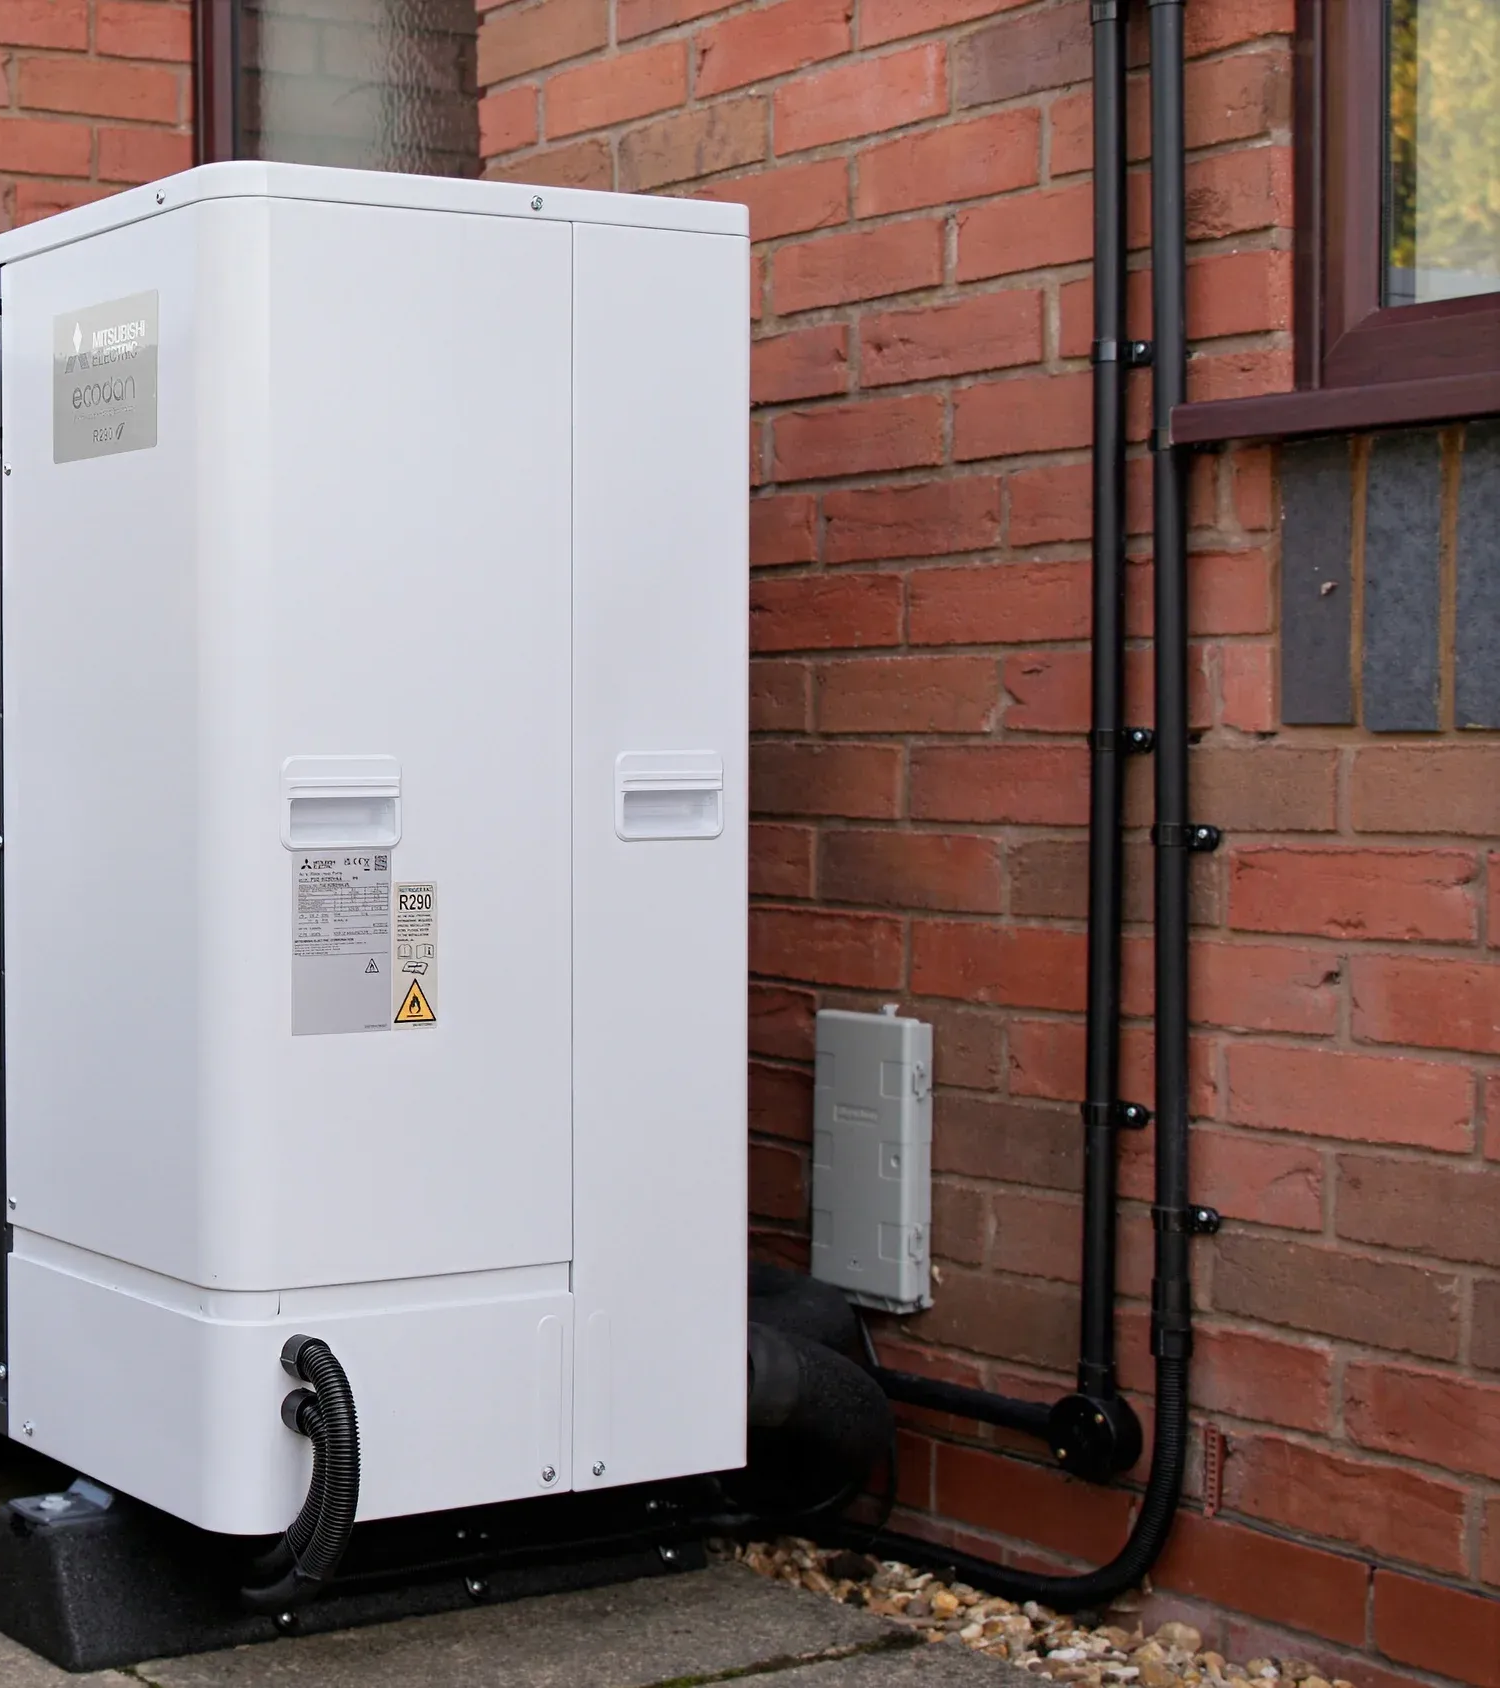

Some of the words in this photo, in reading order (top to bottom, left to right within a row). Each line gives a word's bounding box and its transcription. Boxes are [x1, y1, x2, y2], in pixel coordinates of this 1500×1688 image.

[92, 320, 146, 349] MITSUBISHI
[92, 341, 138, 367] ELECTRIC
[72, 375, 136, 409] ecodan
[399, 894, 432, 910] R290
